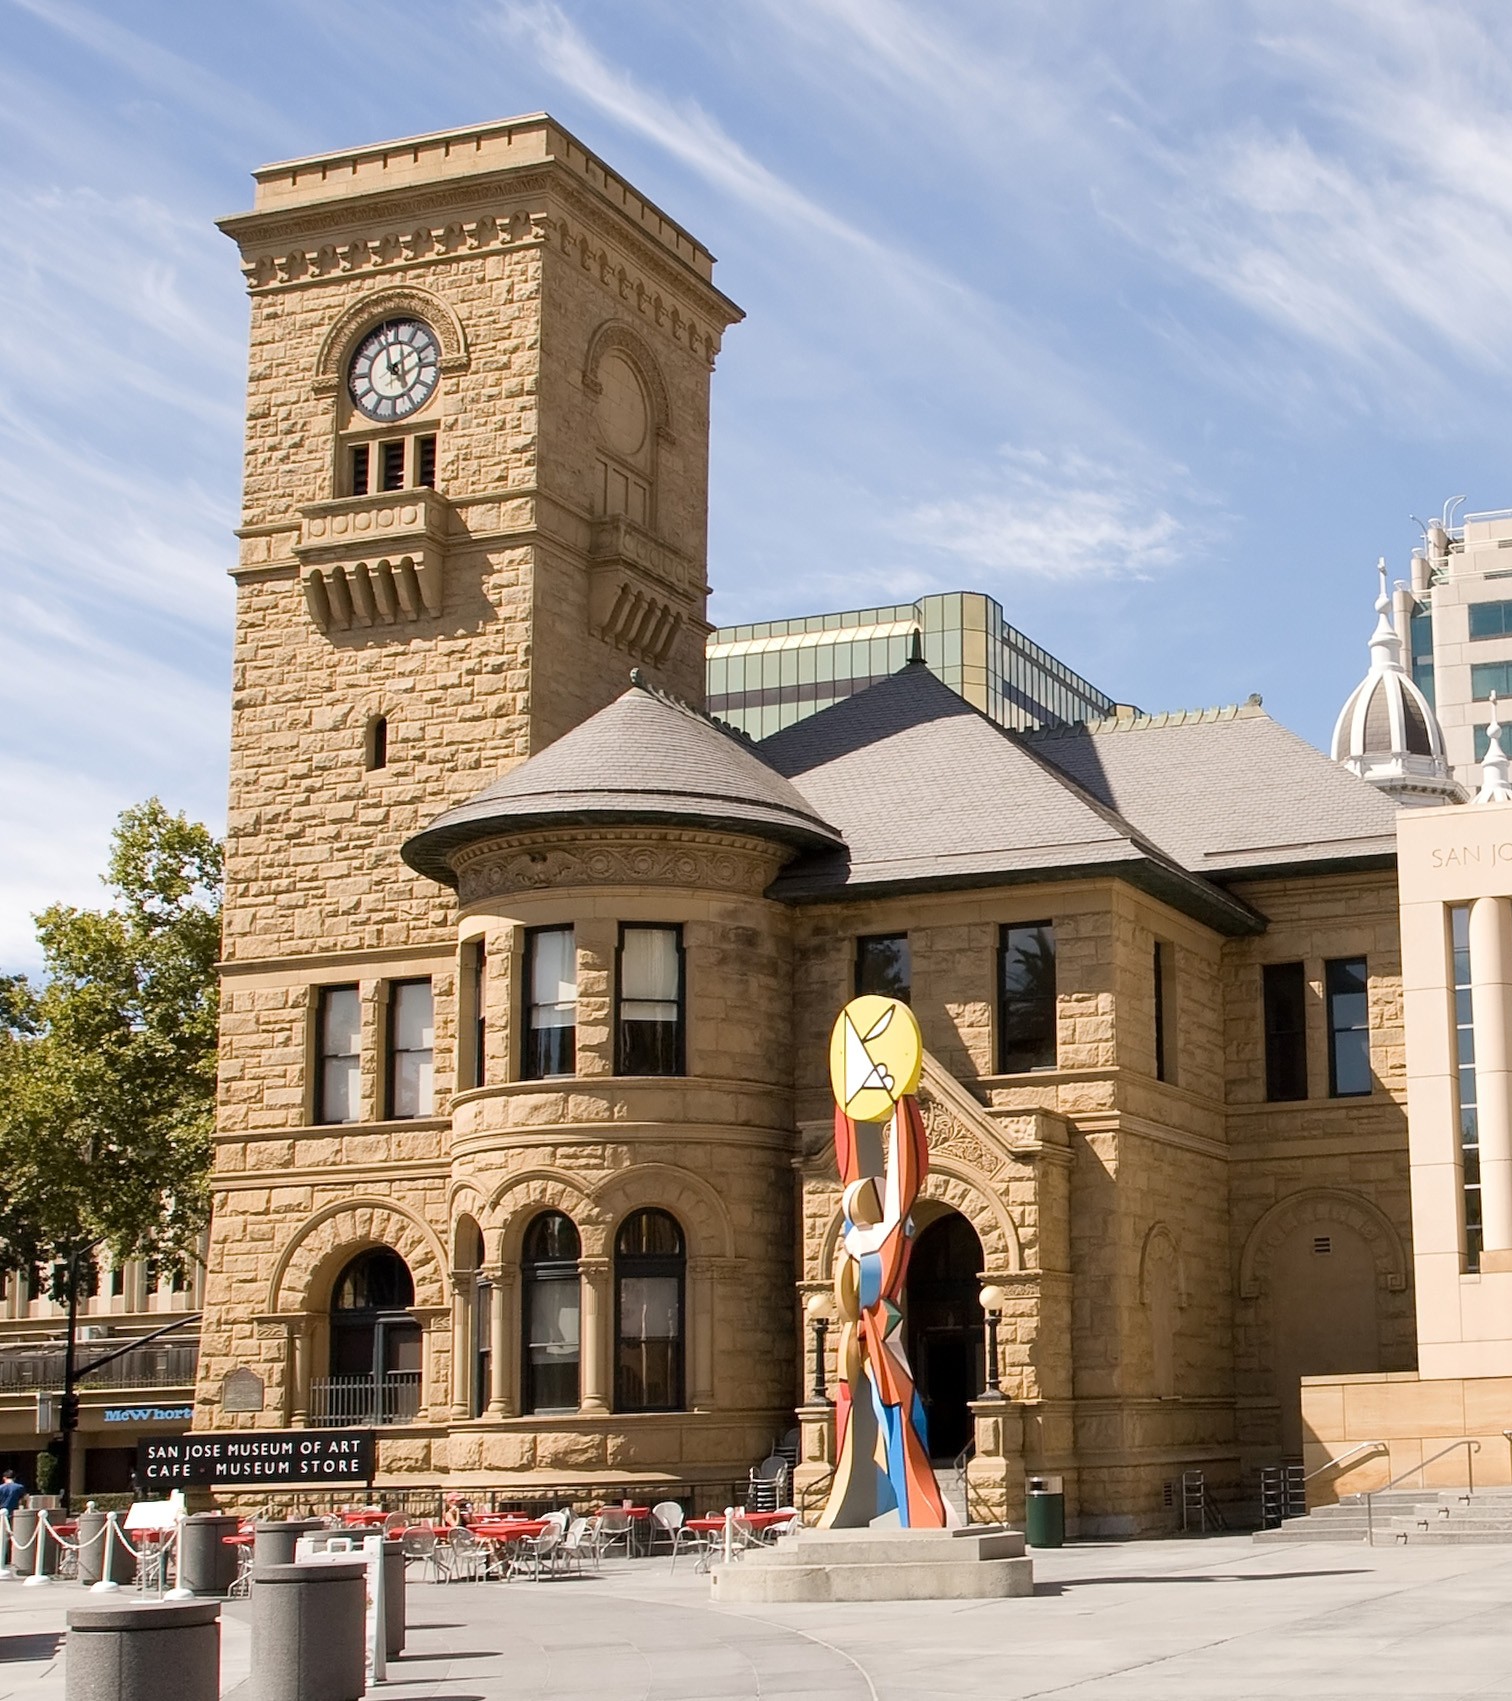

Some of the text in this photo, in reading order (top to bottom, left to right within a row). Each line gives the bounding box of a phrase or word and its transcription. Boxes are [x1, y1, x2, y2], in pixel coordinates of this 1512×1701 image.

[1431, 844, 1481, 869] SAN
[148, 1440, 361, 1461] SAN JOSE MUSEUM OF ART
[147, 1459, 360, 1478] CAFE MUSEUM STORE
